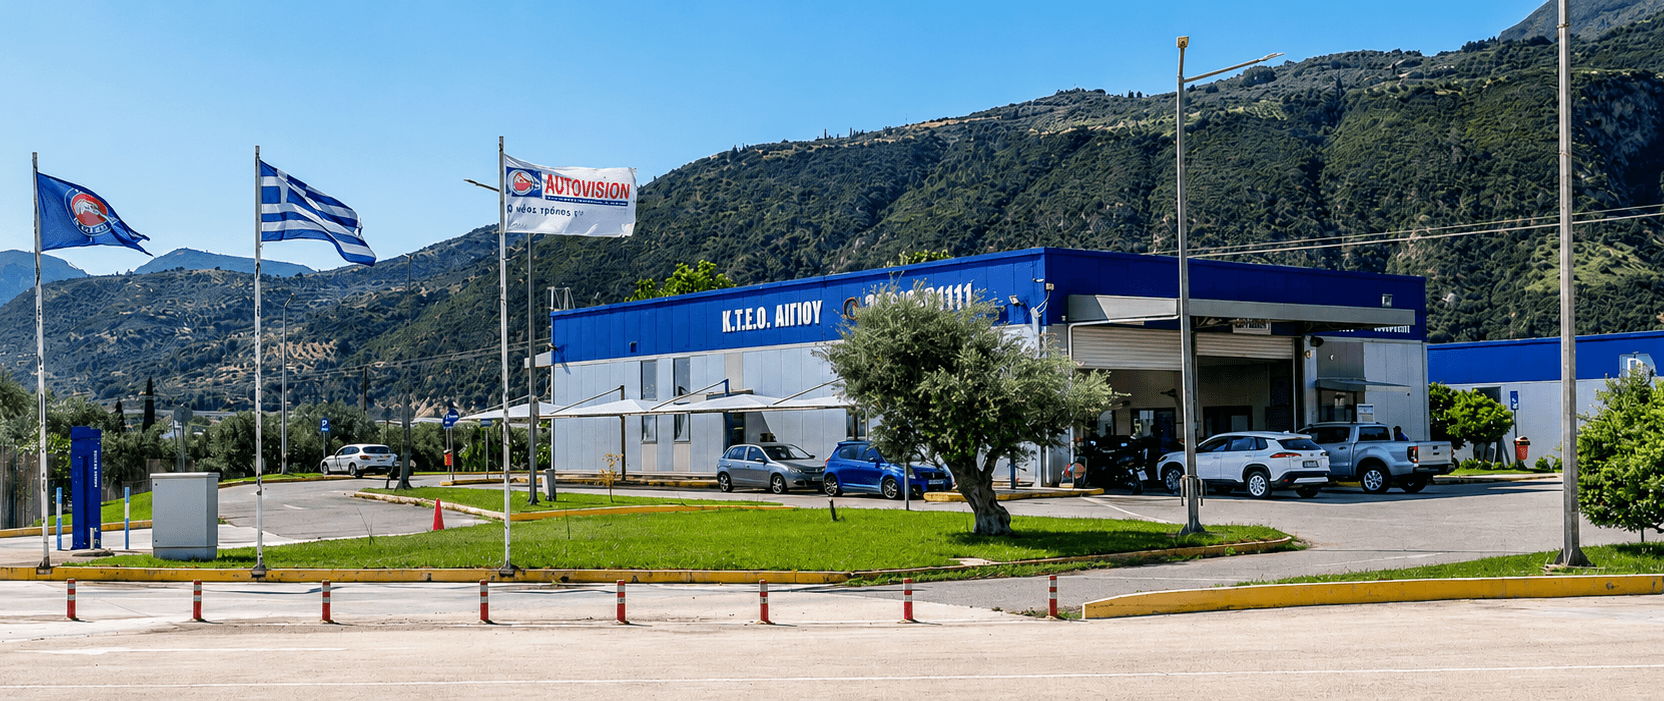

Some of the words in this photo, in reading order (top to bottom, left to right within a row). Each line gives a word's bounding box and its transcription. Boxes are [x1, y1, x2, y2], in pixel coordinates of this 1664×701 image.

[545, 174, 630, 199] AUTOVISION
[722, 306, 771, 333] Κ.Τ.Ε.Ο.
[775, 300, 823, 327] ΑΙΓΙΟΥ
